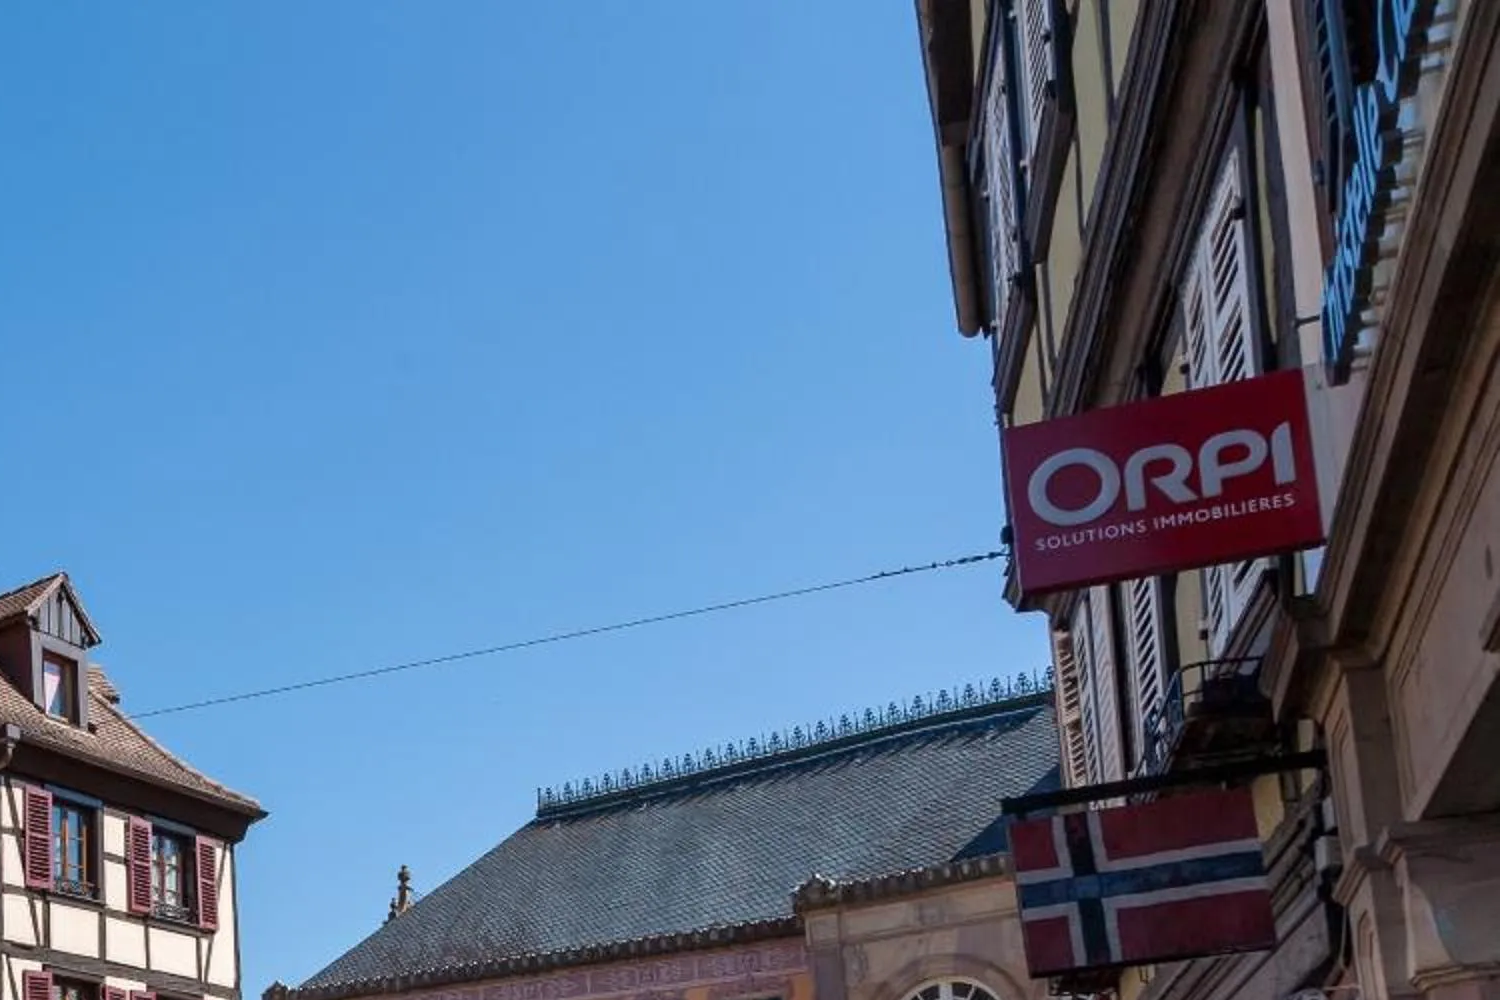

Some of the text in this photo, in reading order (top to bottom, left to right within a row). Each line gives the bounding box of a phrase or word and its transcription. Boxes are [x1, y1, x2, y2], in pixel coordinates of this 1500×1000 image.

[1027, 420, 1297, 526] ORPI
[1034, 493, 1296, 551] SOLUTIONS IMMOBILIERES
